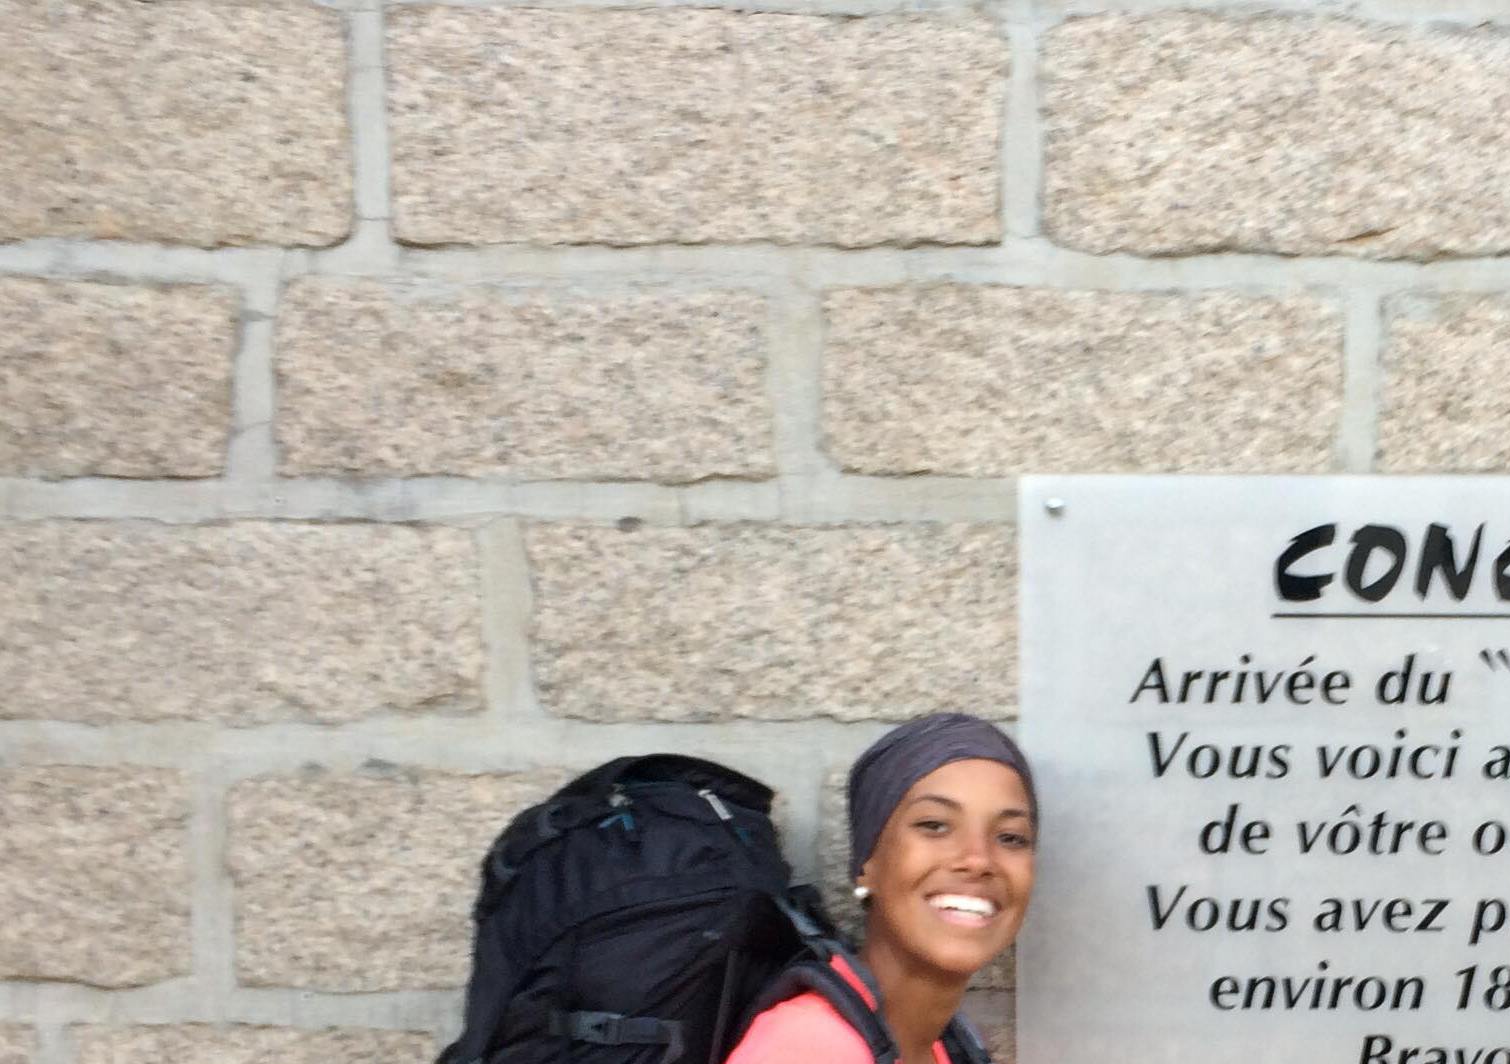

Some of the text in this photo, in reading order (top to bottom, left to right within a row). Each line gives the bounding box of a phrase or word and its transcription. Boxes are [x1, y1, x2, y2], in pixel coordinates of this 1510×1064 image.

[1129, 653, 1353, 707] Arrivée
[1376, 652, 1453, 707] du
[1147, 730, 1291, 780] Vous
[1318, 728, 1463, 780] voici
[1199, 802, 1272, 856] de
[1296, 803, 1449, 856] vôtre
[1146, 884, 1290, 933] Vous
[1312, 897, 1450, 933] avez
[1209, 960, 1426, 1012] environ
